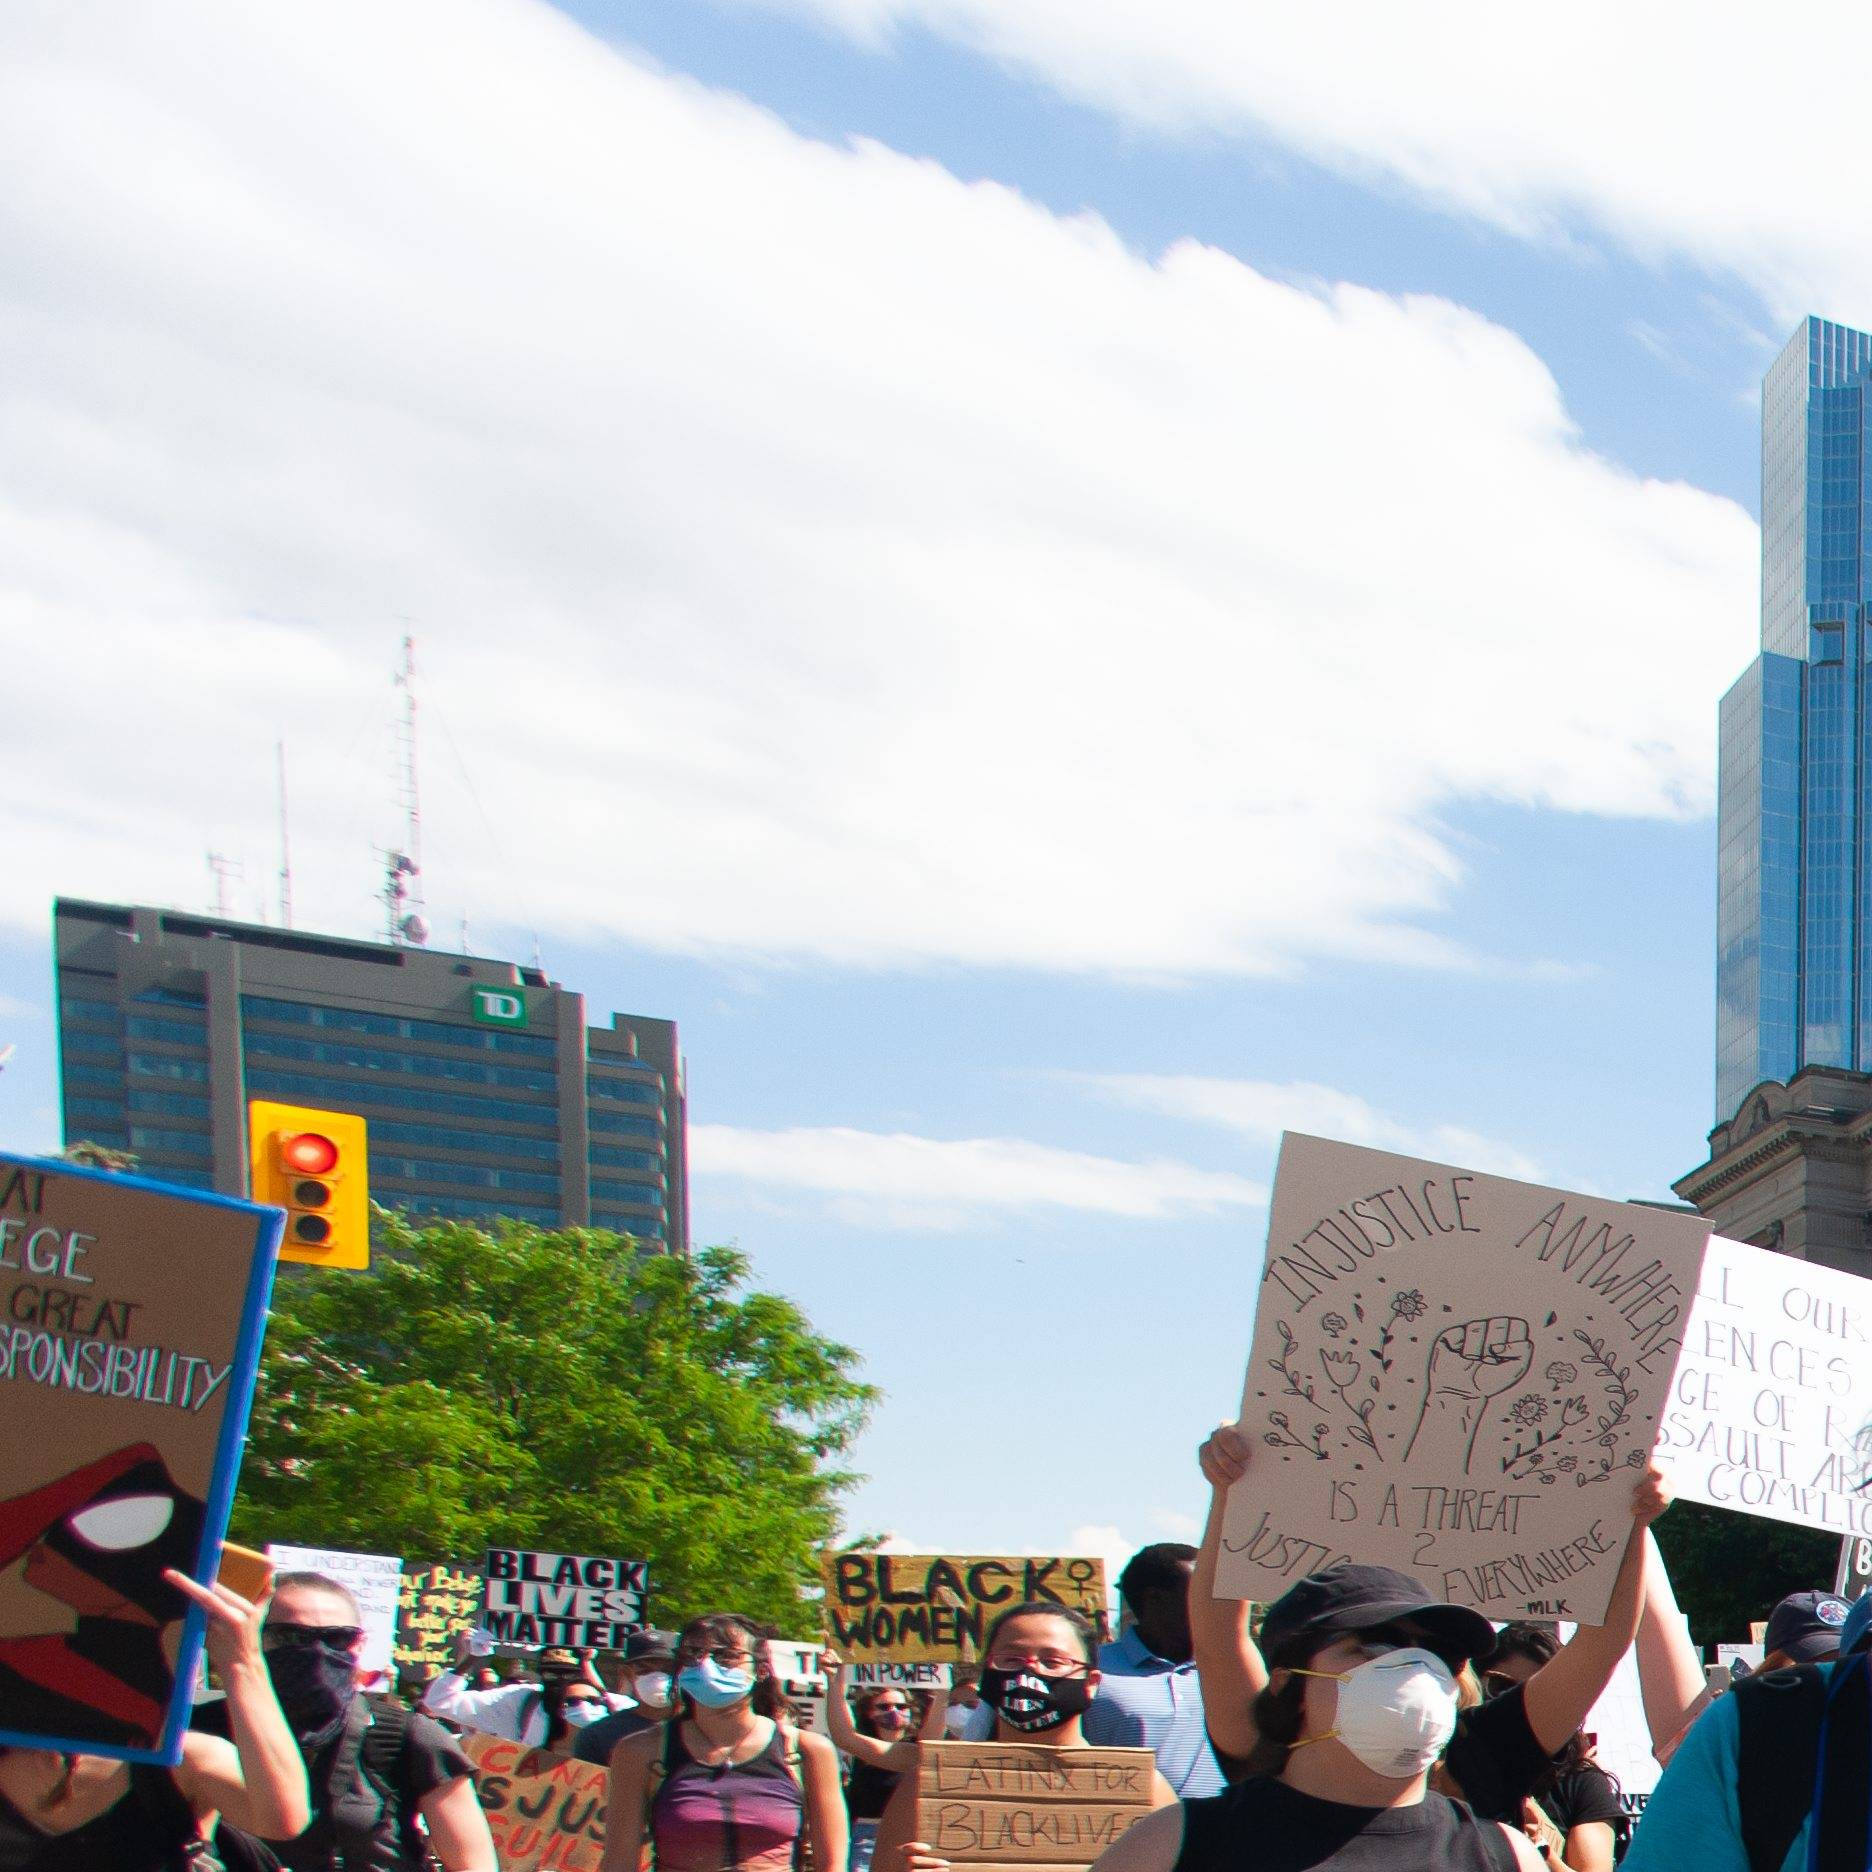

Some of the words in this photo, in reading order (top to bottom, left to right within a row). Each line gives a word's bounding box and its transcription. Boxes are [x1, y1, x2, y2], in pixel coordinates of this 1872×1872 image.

[475, 991, 520, 1019] TD
[1263, 1176, 1481, 1313] INJUSTICE
[1515, 1201, 1683, 1374] ANYWHERE
[1782, 1286, 1870, 1343] OUR
[1702, 1318, 1852, 1397] ENCES
[1659, 1412, 1796, 1476] SSAULT
[1330, 1481, 1357, 1523] IS
[1377, 1489, 1400, 1528] A
[1411, 1486, 1540, 1535] THREAT
[489, 1550, 644, 1592] BLACK
[834, 1553, 1067, 1606] BLACK
[1223, 1511, 1353, 1577] JUSTIC
[1413, 1533, 1439, 1568] 2
[1442, 1519, 1617, 1606] EVERYWHERE
[485, 1579, 641, 1623] LIVES
[831, 1601, 985, 1650] WOMEN
[484, 1611, 643, 1649] MATTER
[854, 1663, 875, 1683] IN
[879, 1662, 942, 1684] POWER
[936, 1753, 1078, 1792] LATINX
[1094, 1760, 1142, 1793] FOR
[1053, 1811, 1145, 1845] LIVE
